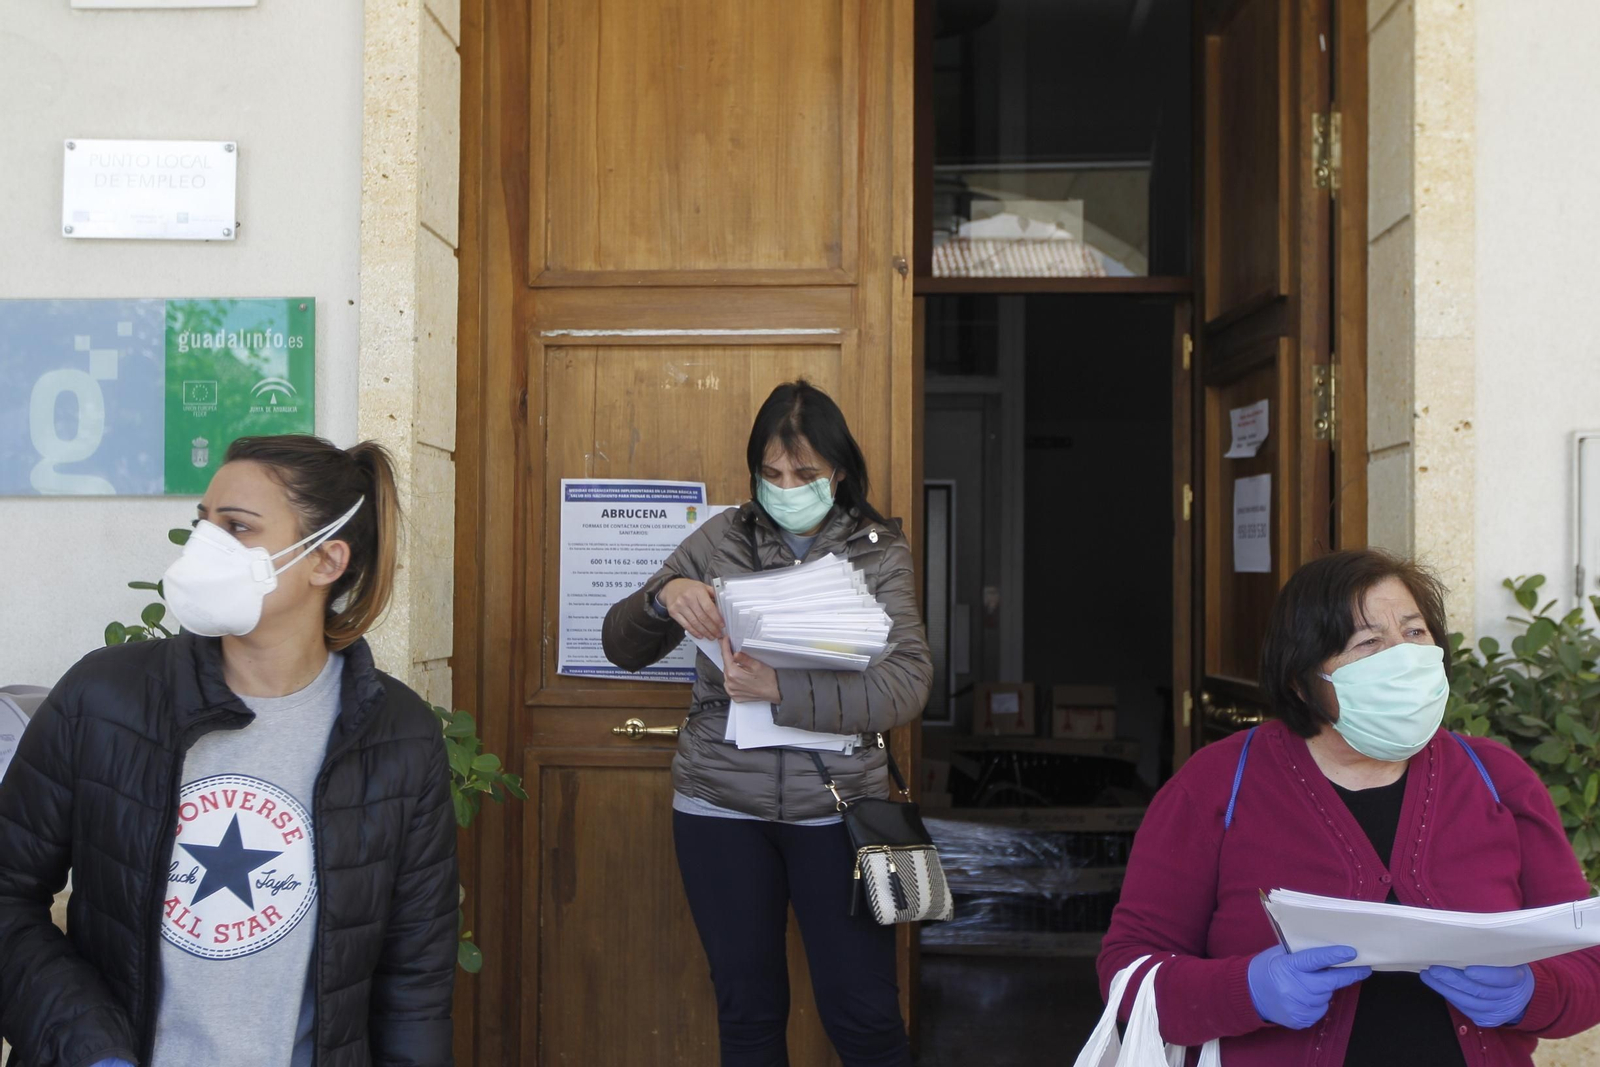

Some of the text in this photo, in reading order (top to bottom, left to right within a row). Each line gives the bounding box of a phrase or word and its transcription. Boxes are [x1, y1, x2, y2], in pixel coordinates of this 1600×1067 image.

[90, 153, 213, 170] PUNTO LOCAL
[94, 172, 206, 189] DE EMPLEO
[601, 509, 667, 519] ABRUCENA
[173, 789, 304, 845] ONVERSE
[255, 869, 302, 896] Taylor
[164, 896, 283, 943] ALL STAR
